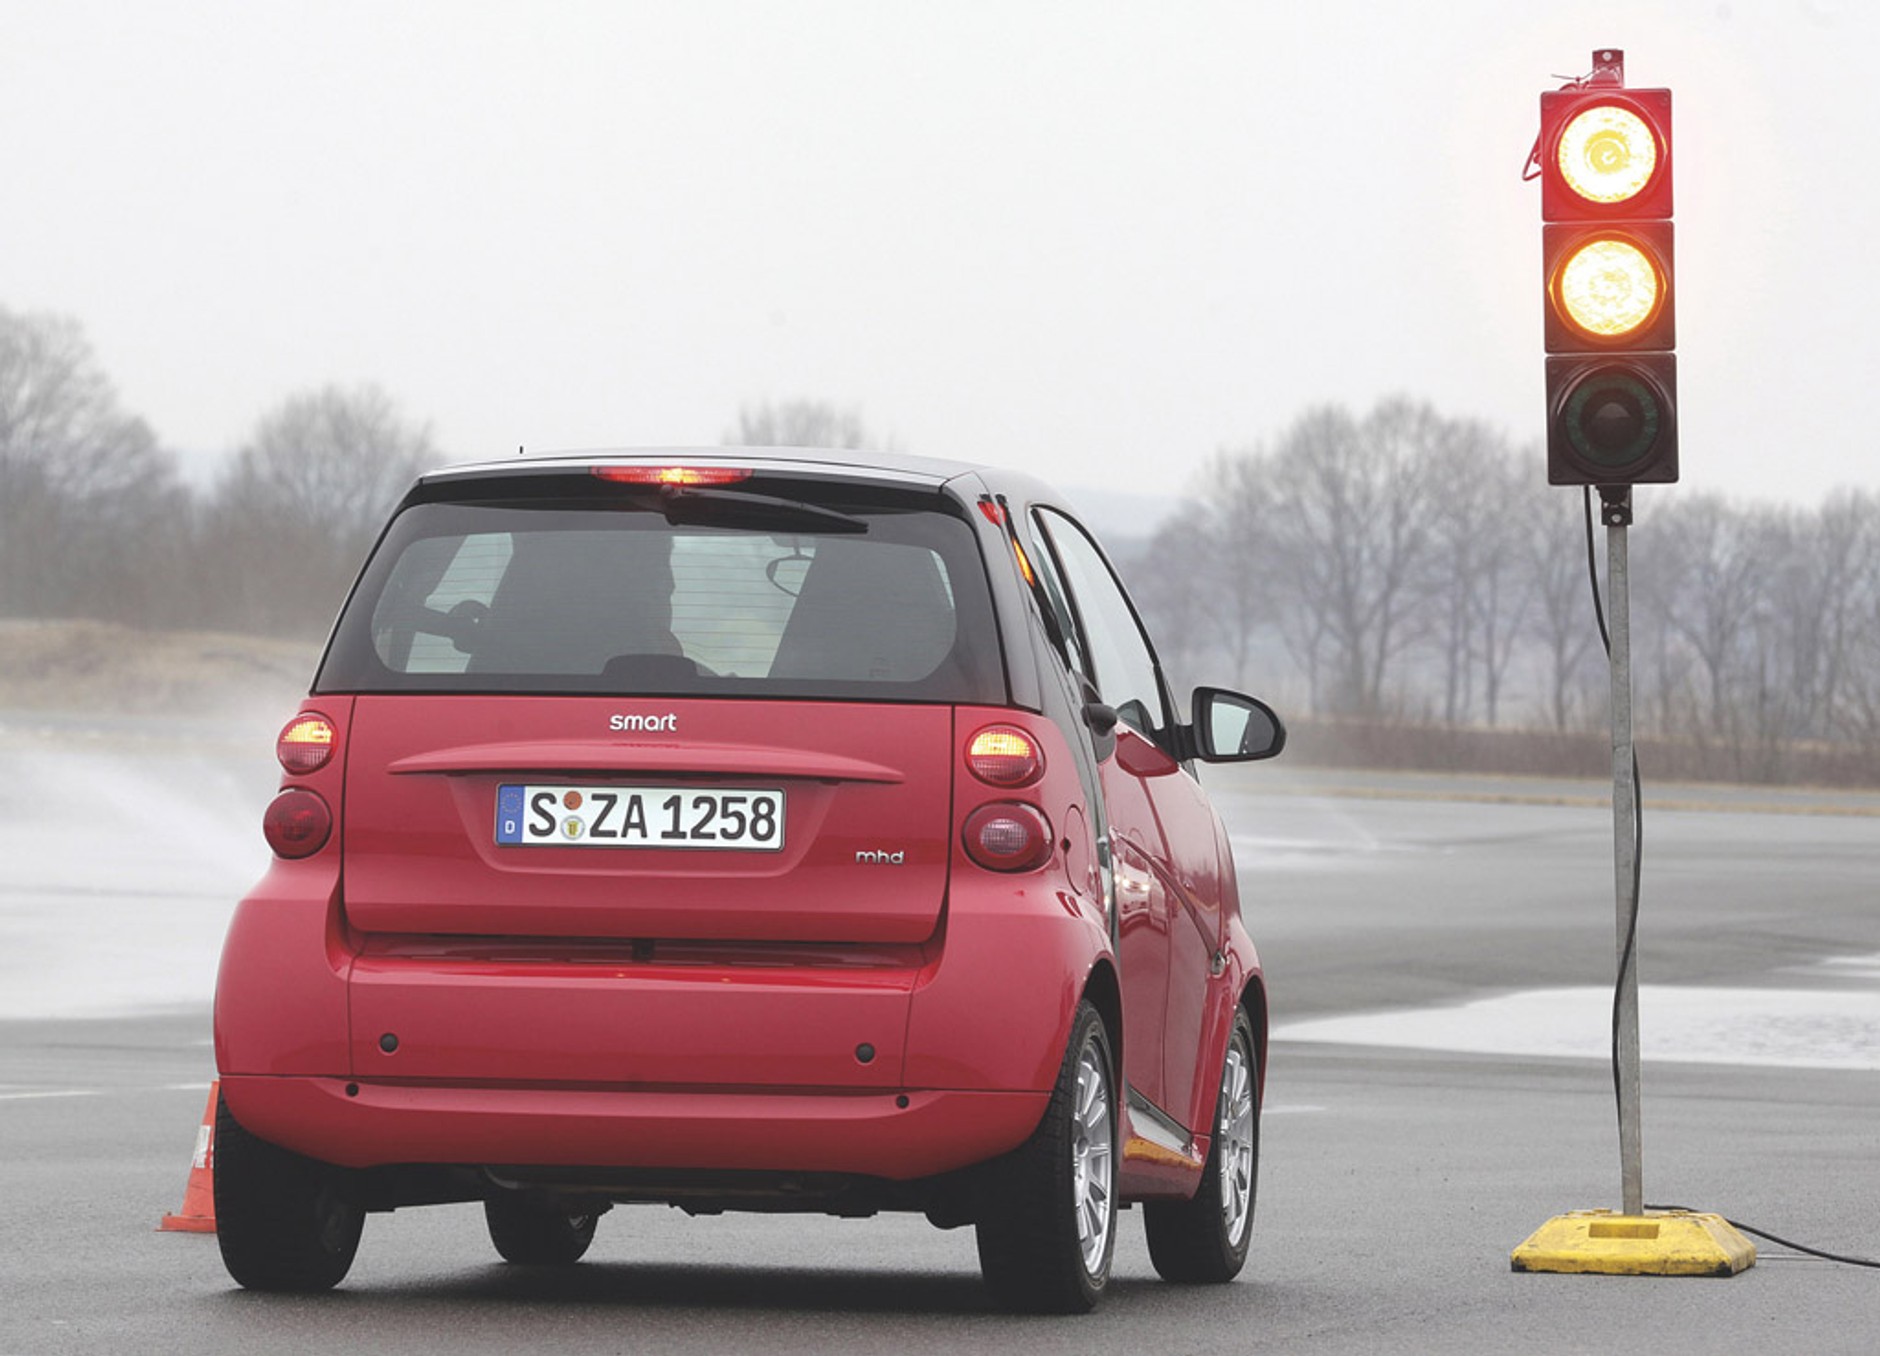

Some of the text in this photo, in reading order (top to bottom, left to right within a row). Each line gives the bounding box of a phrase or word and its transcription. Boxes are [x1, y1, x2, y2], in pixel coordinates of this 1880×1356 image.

[609, 713, 677, 731] smart
[528, 792, 776, 842] S ZA 1258
[504, 820, 516, 834] D
[855, 850, 905, 865] mhd
